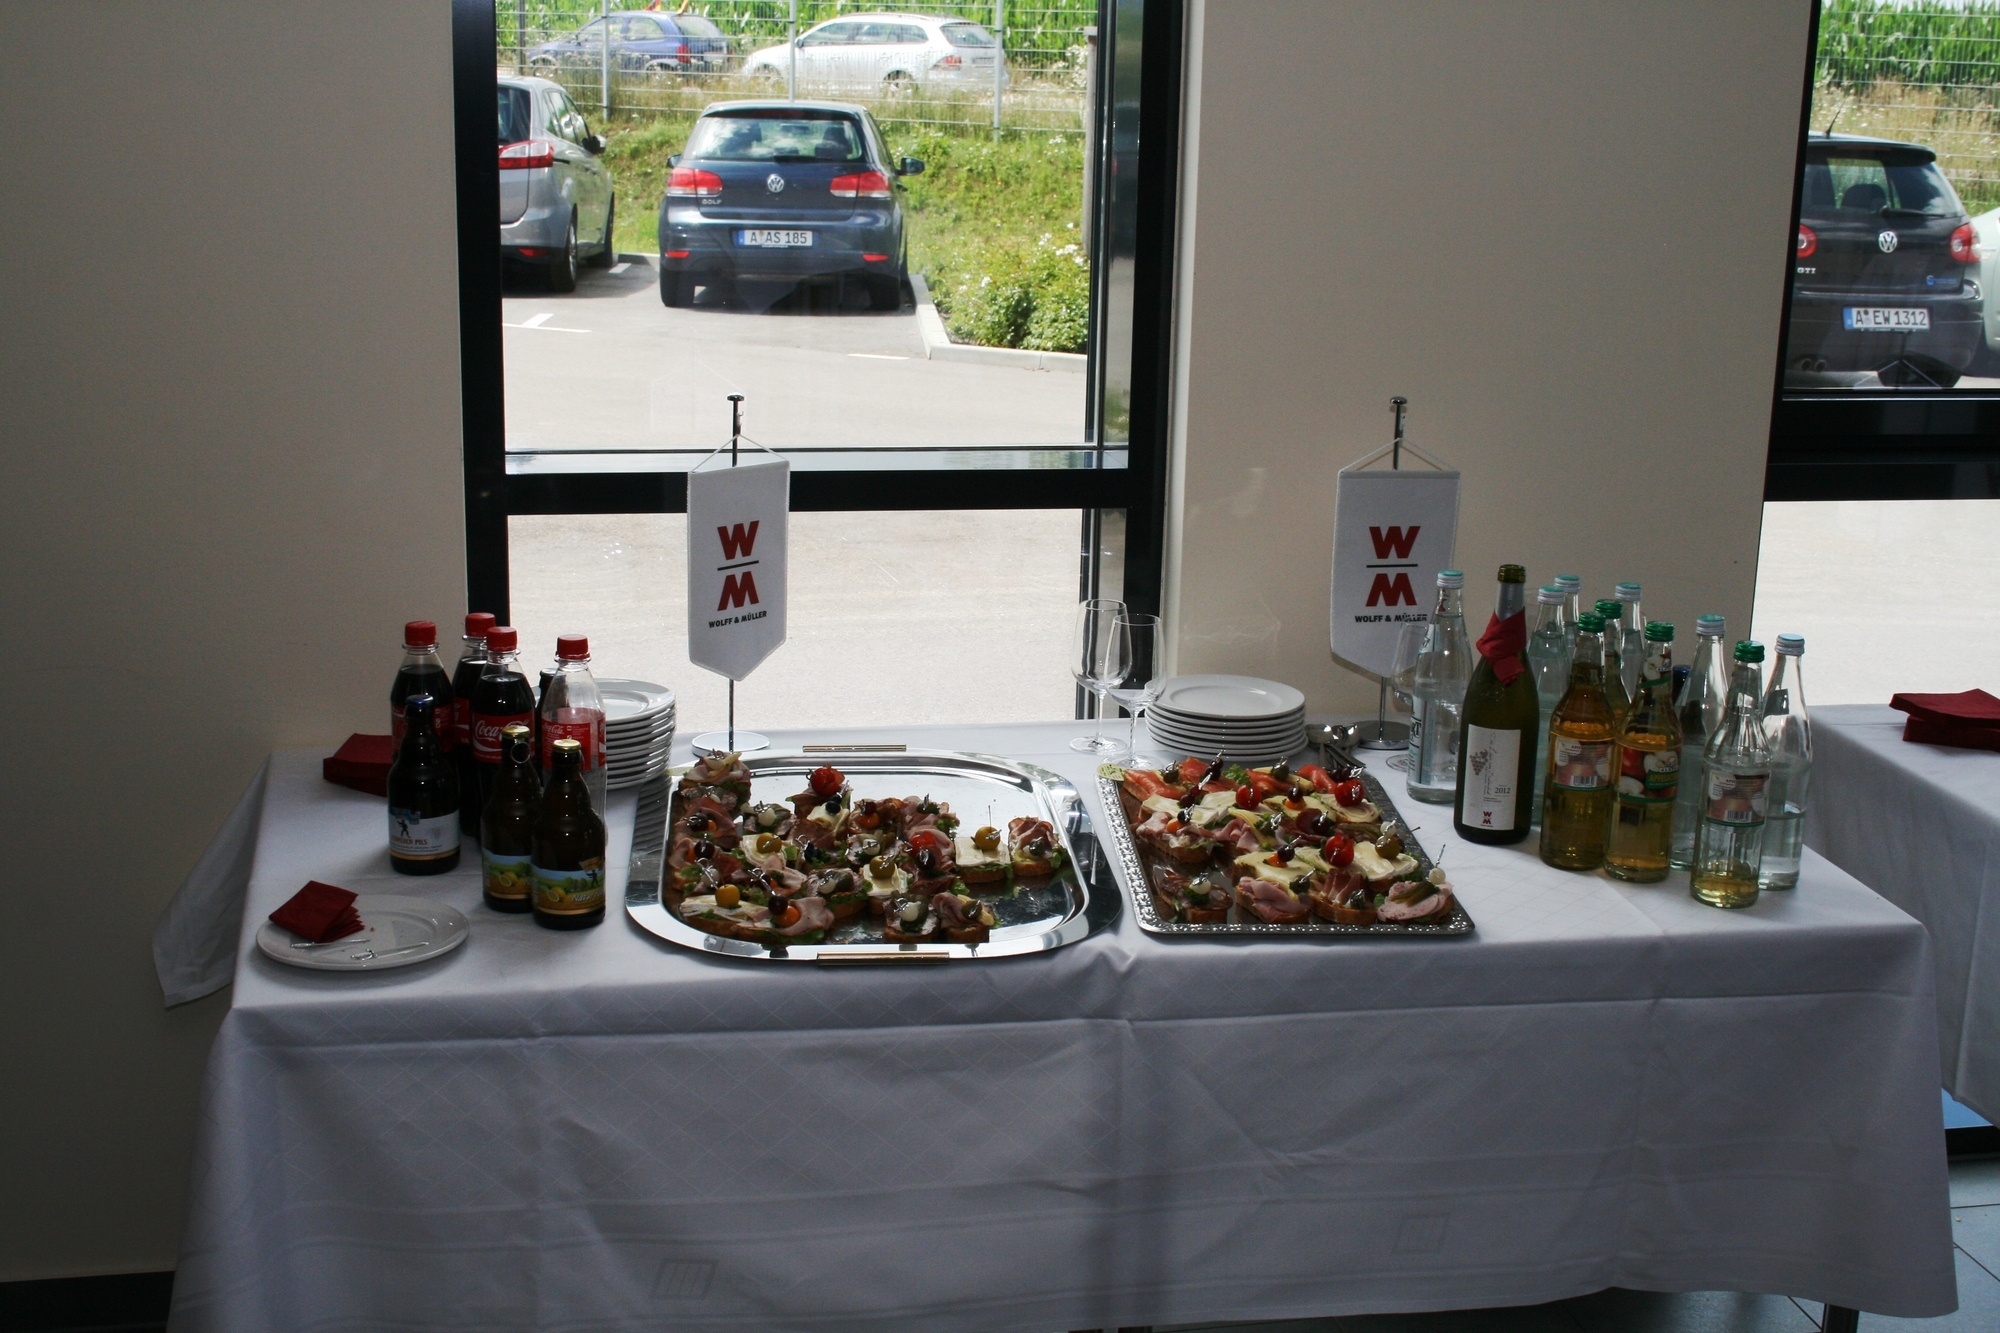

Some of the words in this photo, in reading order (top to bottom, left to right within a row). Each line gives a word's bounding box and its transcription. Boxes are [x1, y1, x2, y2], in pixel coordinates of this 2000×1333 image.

[750, 231, 758, 244] A
[765, 231, 781, 244] AS
[785, 231, 807, 244] 185
[1855, 310, 1864, 325] A
[1873, 310, 1890, 325] EW
[1894, 310, 1927, 326] 1312
[717, 520, 760, 560] W
[1368, 525, 1421, 559] W
[717, 570, 760, 612] M
[1365, 572, 1418, 607] M
[708, 617, 733, 628] WOLFF
[741, 610, 767, 623] MÜLLER
[1354, 615, 1383, 623] WOLFF
[1394, 612, 1428, 623] MÜLLER
